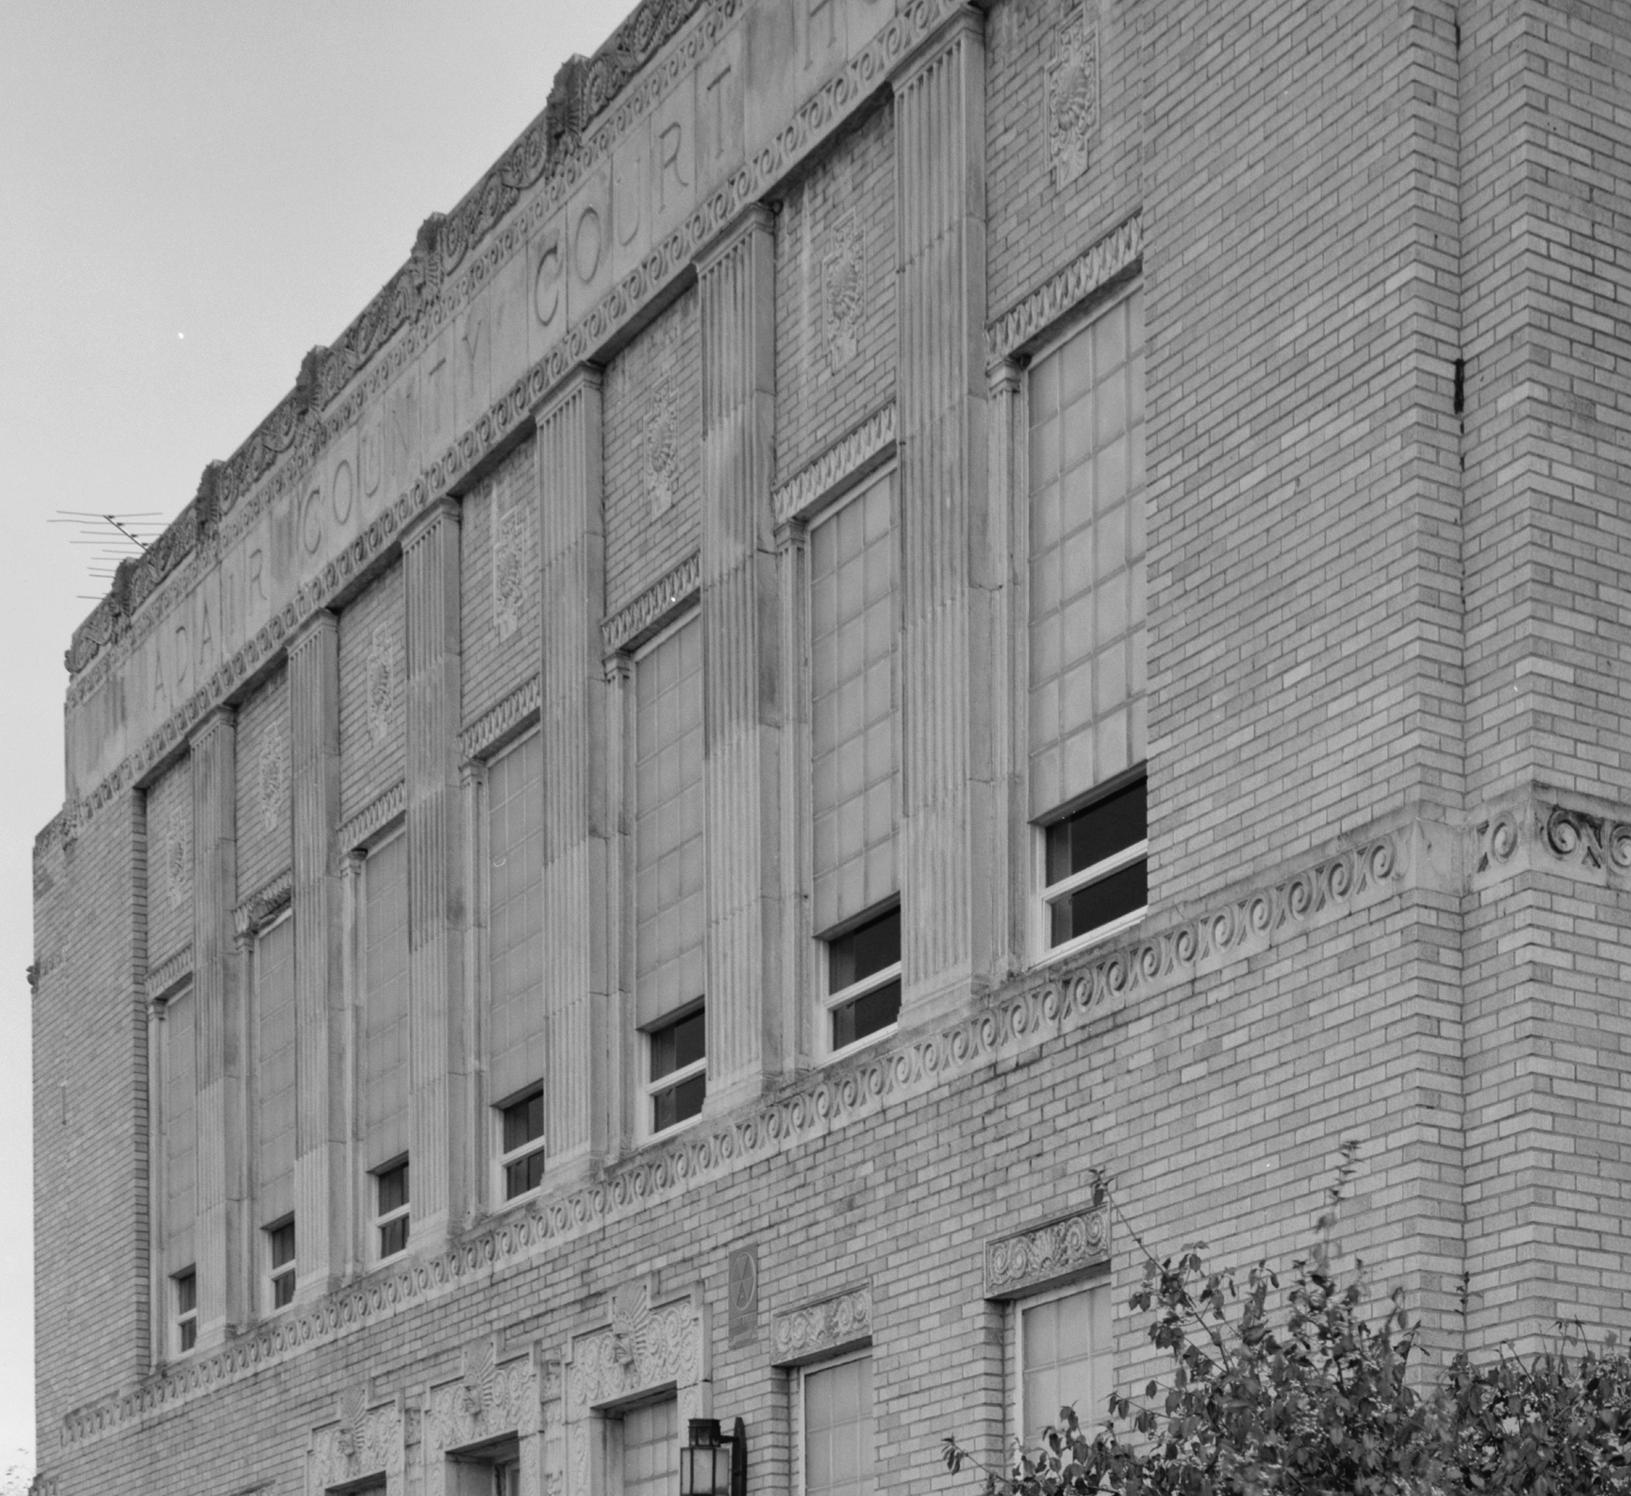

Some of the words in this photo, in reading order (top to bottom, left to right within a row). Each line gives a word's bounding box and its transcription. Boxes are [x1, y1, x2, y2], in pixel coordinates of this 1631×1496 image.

[152, 547, 268, 712] ADAIR
[303, 316, 483, 555] COUNTY
[534, 63, 732, 327] COURT
